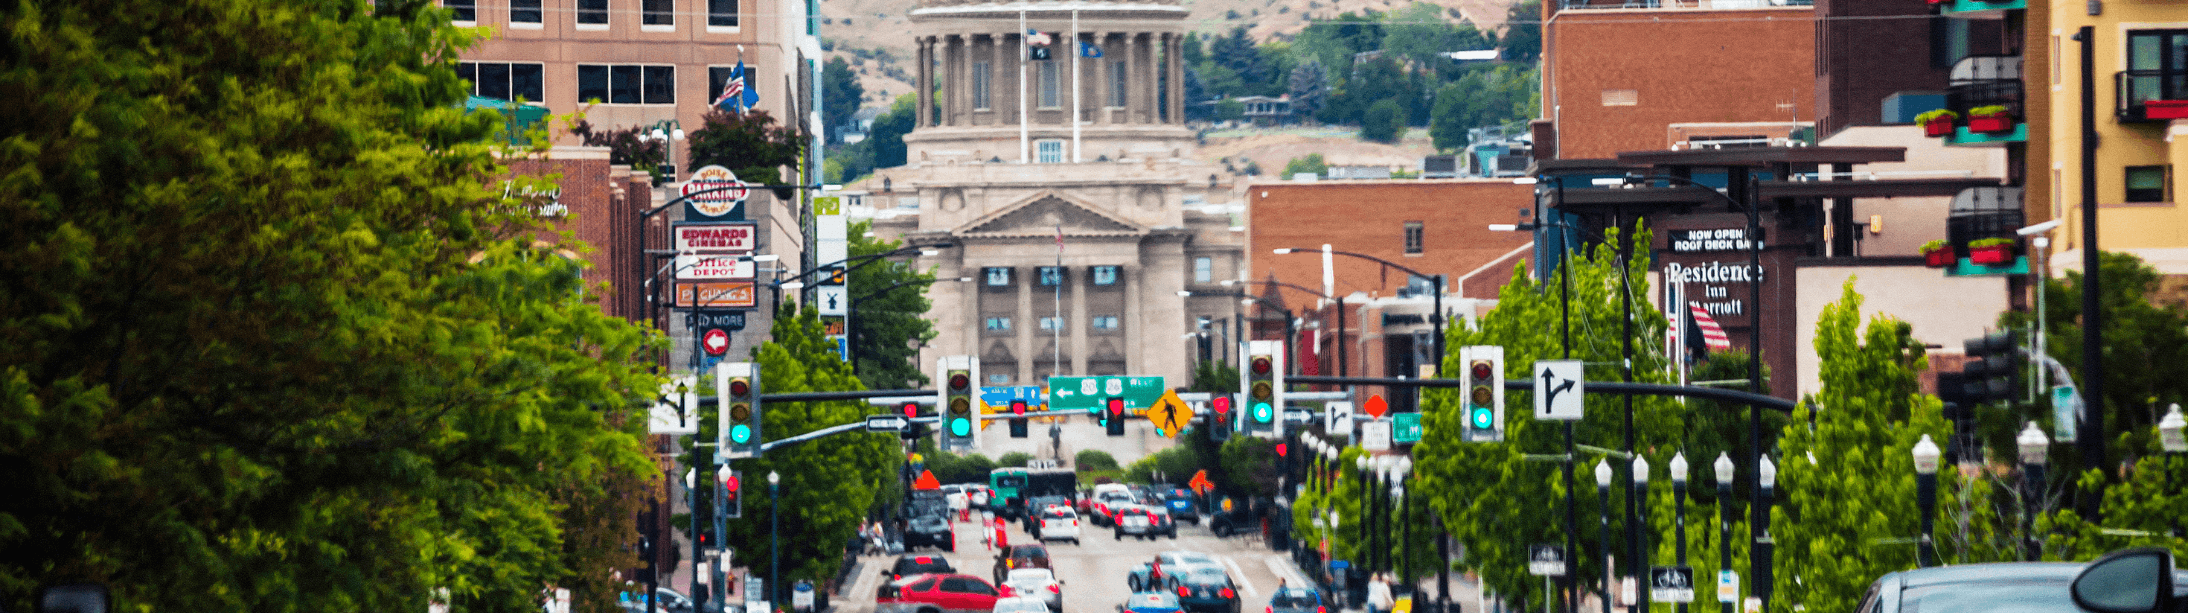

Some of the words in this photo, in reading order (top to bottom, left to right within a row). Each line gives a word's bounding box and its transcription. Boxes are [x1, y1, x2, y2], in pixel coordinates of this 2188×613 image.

[700, 169, 729, 180] BOISE
[688, 182, 743, 199] PARKING
[682, 229, 748, 240] EDWARDS
[1688, 229, 1713, 241] NOW
[1714, 229, 1743, 240] OPEN
[688, 239, 742, 248] CINEMAS
[1674, 240, 1703, 252] ROOF
[1704, 239, 1734, 250] DECK
[693, 268, 736, 277] DEPOT
[1669, 261, 1763, 282] Residence
[1705, 283, 1728, 298] Inn
[713, 314, 743, 327] MORE
